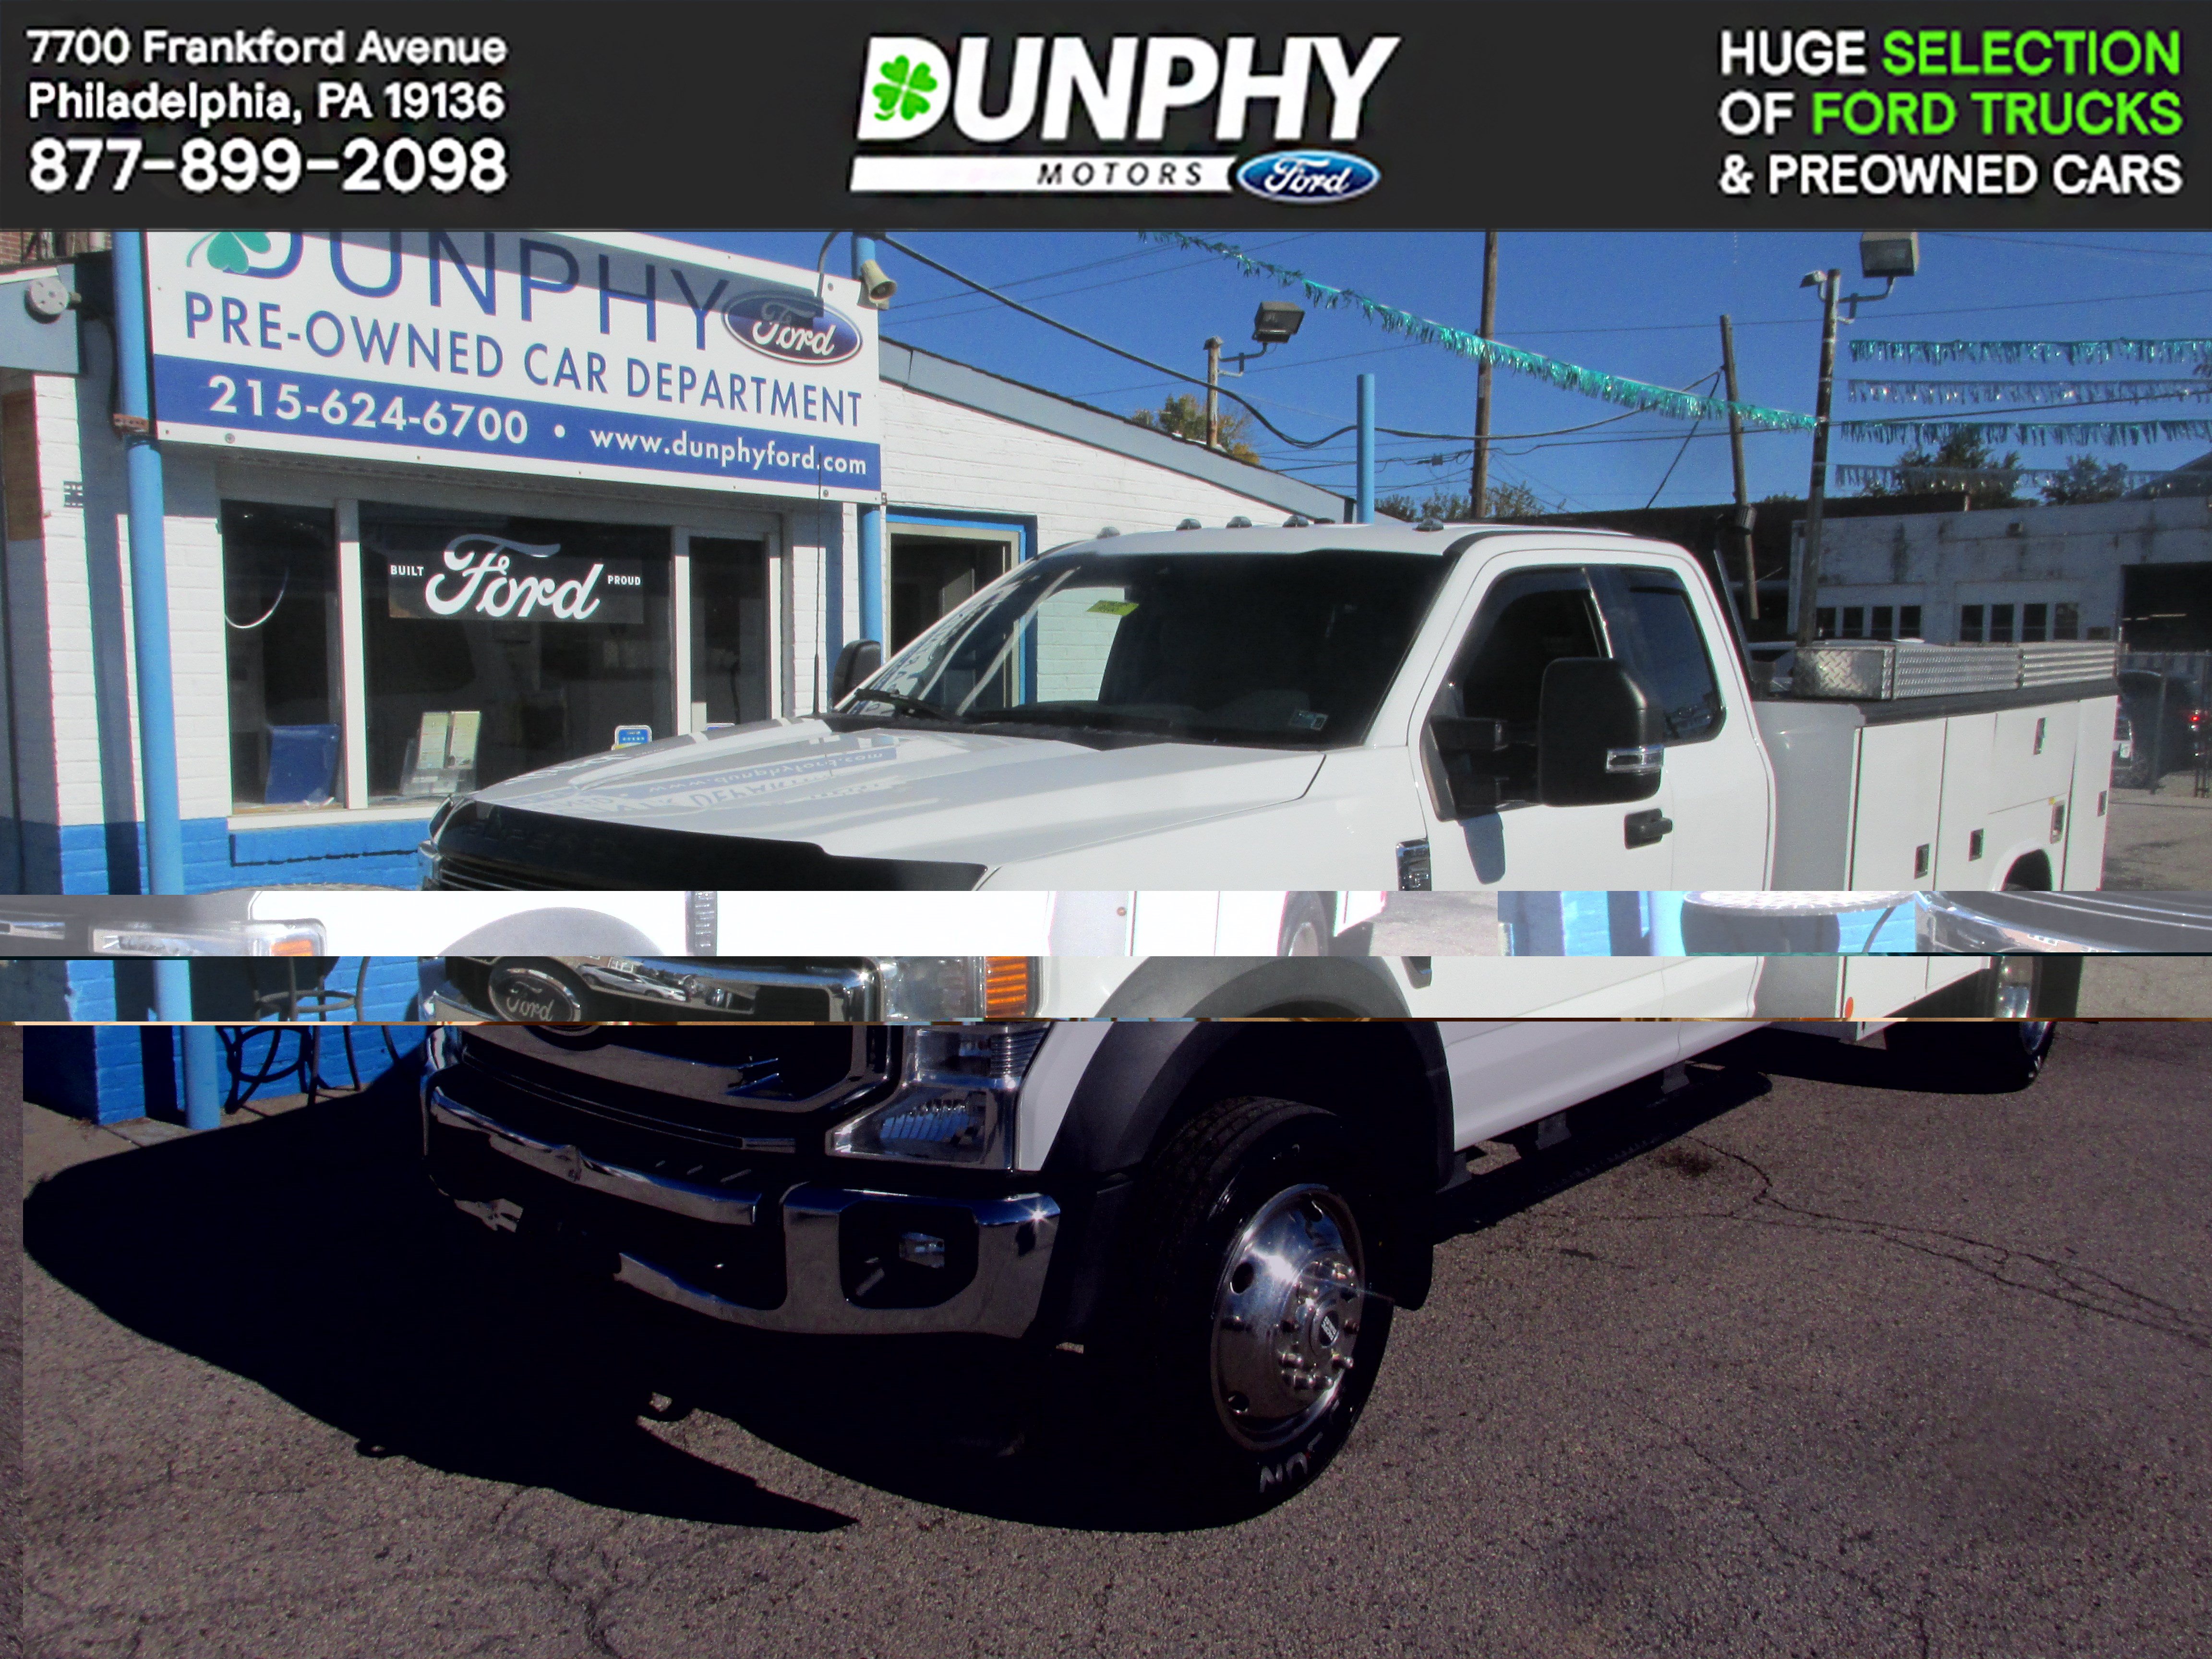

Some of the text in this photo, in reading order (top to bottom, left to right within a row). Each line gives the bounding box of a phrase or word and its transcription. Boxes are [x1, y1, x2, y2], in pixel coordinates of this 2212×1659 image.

[185, 290, 862, 427] PRE-OWNED CAR DEPARTMENT
[752, 301, 836, 357] Ford
[208, 375, 866, 475] 215-624-6700 www.dunphyford.com
[390, 533, 641, 620] BUILT Ford PROUD
[506, 981, 554, 1022] Ford
